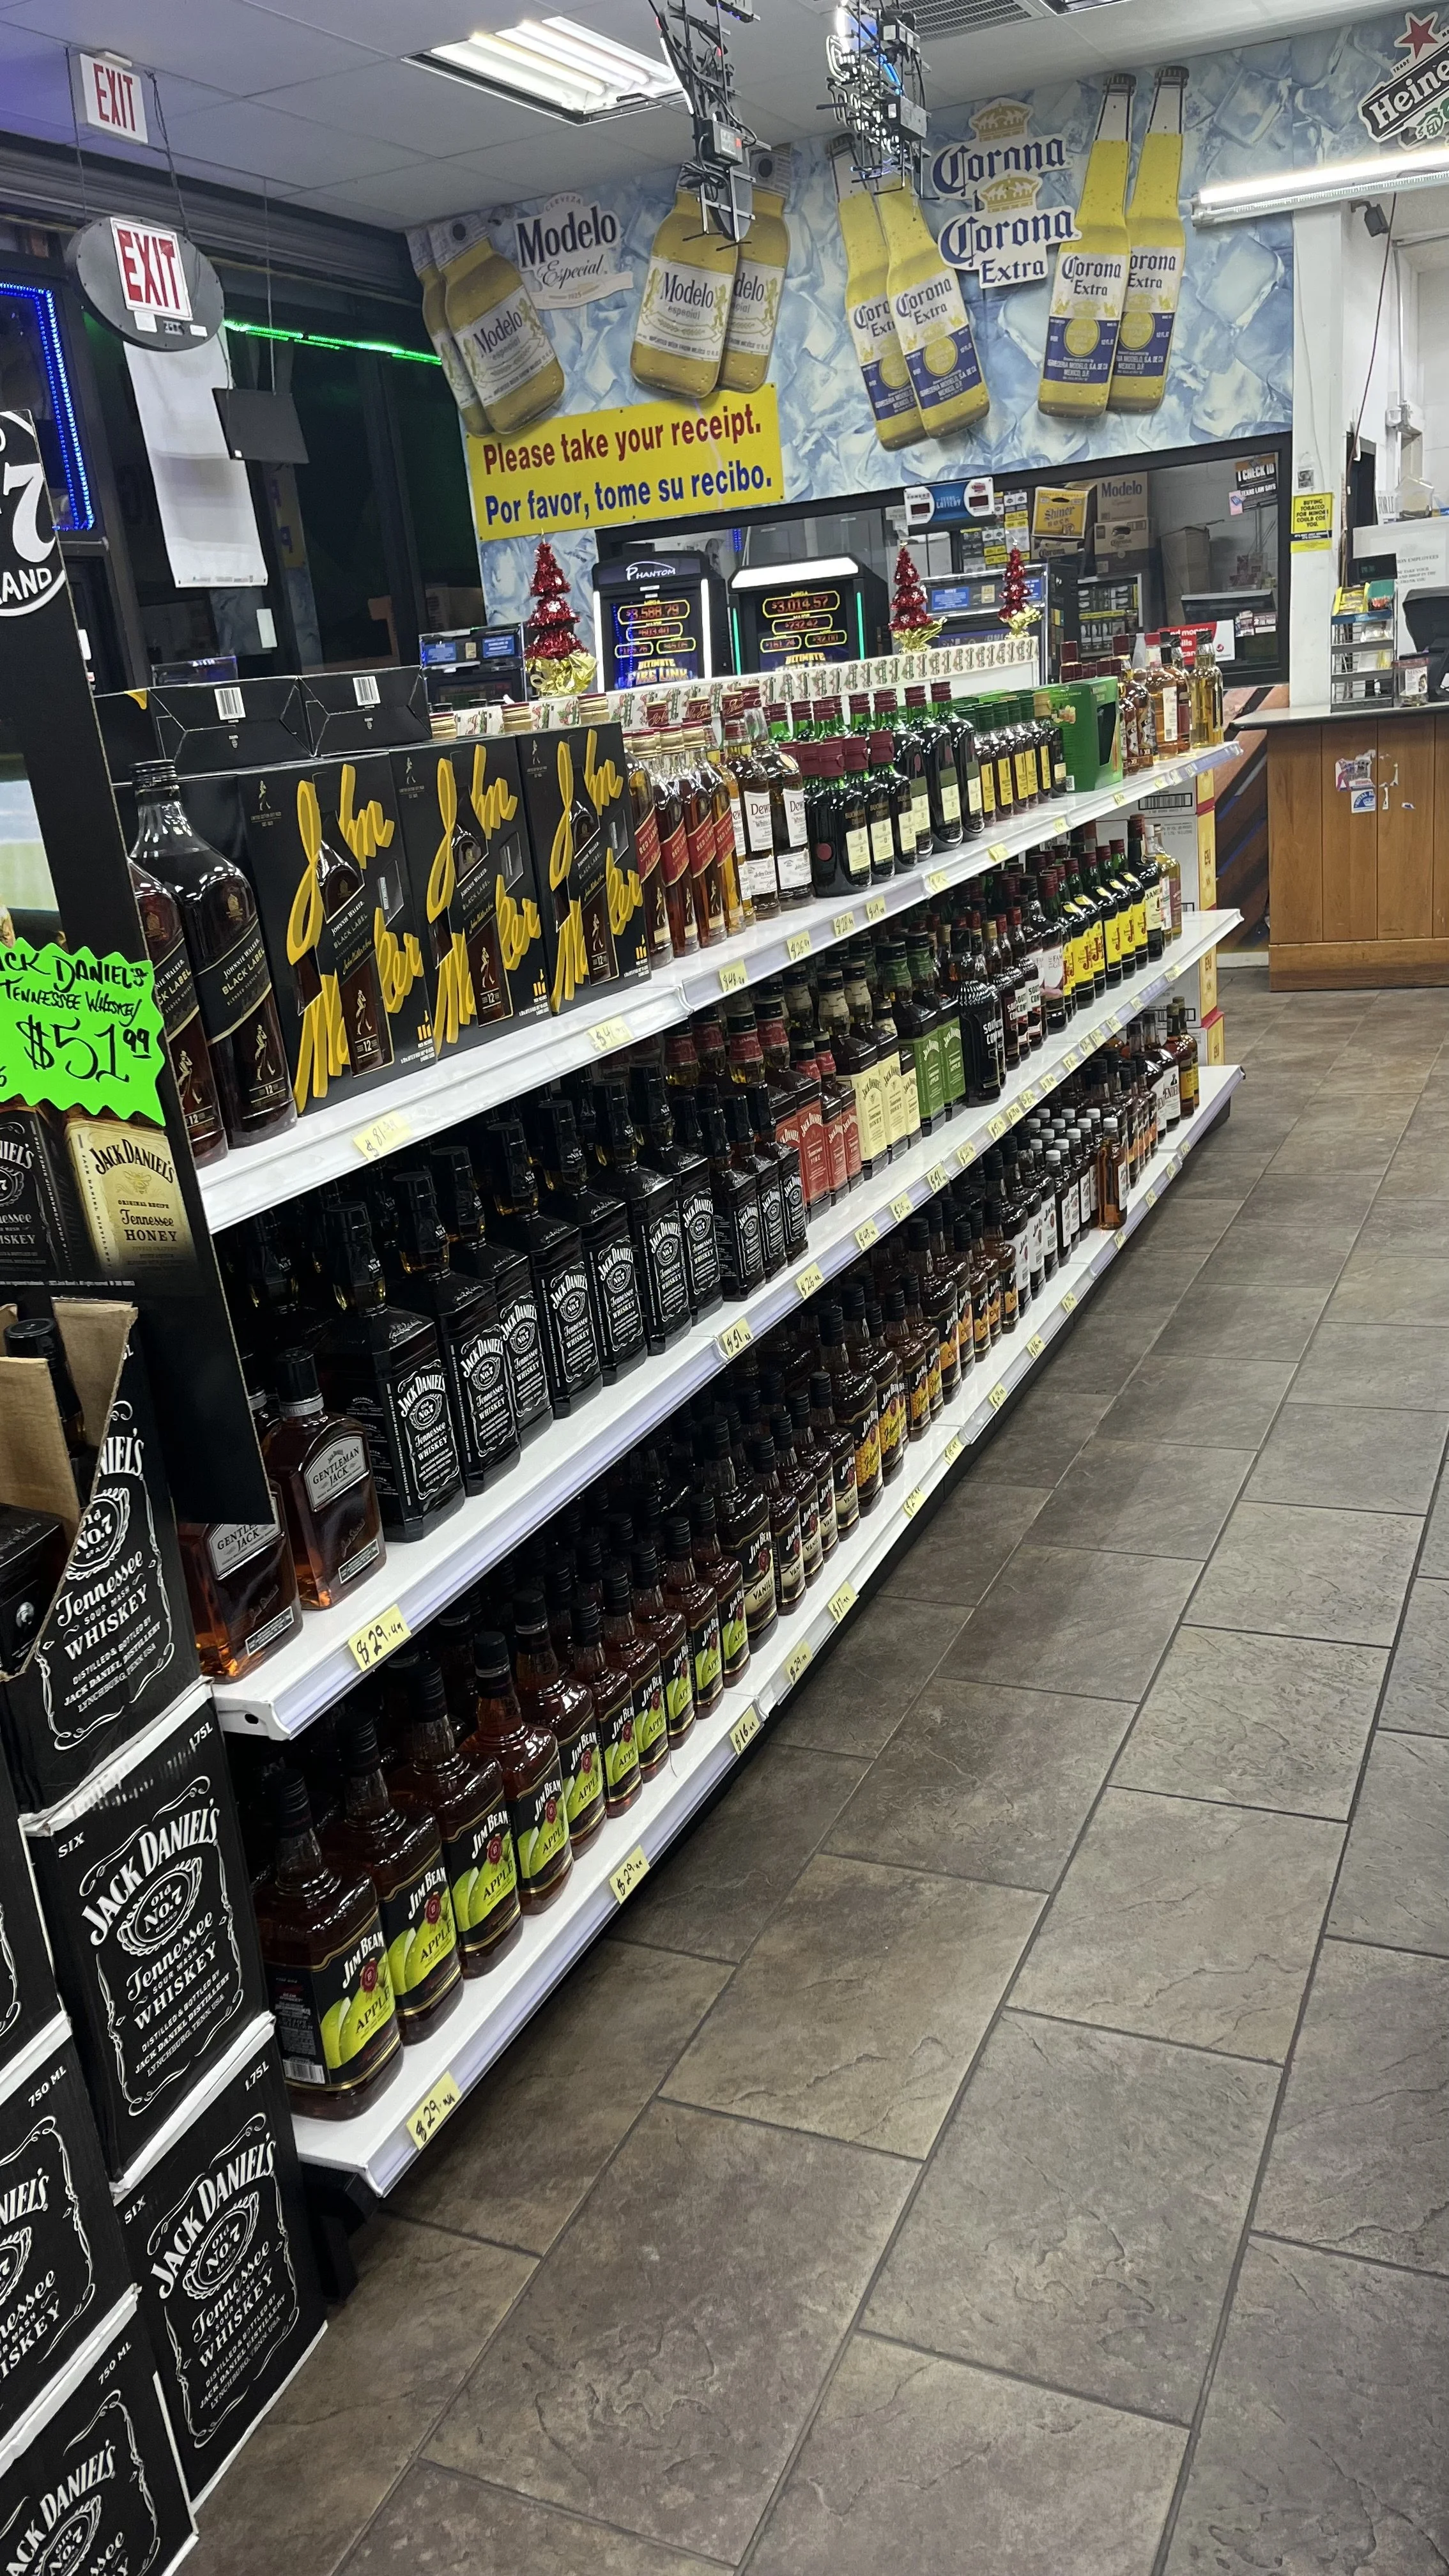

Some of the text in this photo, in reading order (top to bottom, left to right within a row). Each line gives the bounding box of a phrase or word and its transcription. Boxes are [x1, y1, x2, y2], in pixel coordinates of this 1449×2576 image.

[93, 64, 136, 132] EXIT
[933, 138, 1066, 196] Corona
[517, 206, 616, 268] Modelo
[940, 208, 1075, 268] Corona
[118, 229, 182, 310] EXIT
[537, 254, 604, 289] Especial
[981, 259, 1045, 284] Extra
[1062, 256, 1121, 282] Corona
[1128, 273, 1162, 288] Extra
[1130, 255, 1176, 271] orona
[660, 272, 714, 308] Modelo
[735, 273, 764, 302] delo
[896, 279, 952, 318] Corona
[1073, 280, 1108, 296] Extra
[473, 310, 523, 353] Modelo
[854, 300, 889, 330] Coro
[915, 303, 947, 325] Extra
[483, 404, 761, 475] Please take your receipt.
[1101, 480, 1142, 498] Modelo
[1242, 465, 1266, 481] CHECK
[1266, 463, 1275, 475] ID
[485, 460, 771, 525] Por favor, tome su recibo.
[3, 462, 56, 563] 7
[1045, 506, 1075, 521] Shiner
[626, 565, 676, 581] PHANTOM
[785, 652, 825, 664] ULTIMATE
[334, 913, 369, 949] BLACK LABEL
[52, 956, 149, 993] DANIEL'S
[169, 969, 191, 995] LABEL
[222, 947, 265, 995] BLACK LABEL
[224, 956, 245, 980] JOHNNIE
[0, 976, 142, 1027] TENNESSEE WHISKEY
[363, 1039, 372, 1052] 12
[265, 1084, 273, 1094] 12
[188, 1115, 199, 1124] 12
[89, 1138, 174, 1183] JACK DANIEL'S
[120, 1209, 174, 1227] Tennessee
[124, 1229, 177, 1242] HONEY
[550, 1282, 567, 1309] JACK
[567, 1329, 589, 1349] WHISKEY
[397, 1384, 418, 1417] JACK
[415, 1422, 446, 1448] Tennessee
[418, 1436, 447, 1460] WHISKEY
[312, 1446, 360, 1485] GENTLEMAN
[329, 1467, 349, 1487] JACK
[237, 1531, 259, 1550] JACK
[56, 1551, 143, 1627] Tennessee
[84, 1586, 130, 1625] SOUR MASH
[64, 1584, 147, 1660] WHISKEY
[571, 1744, 582, 1770] JIM
[58, 1832, 85, 1858] SIX
[471, 1810, 509, 1859] JIM BEAM
[82, 1798, 220, 1945] JACK DANIEL'S
[483, 1860, 514, 1901] APPLE
[126, 1912, 212, 2001] Tennessee
[153, 1947, 197, 1994] SOUR MASH
[343, 1930, 384, 1989] JIM BEAM
[134, 1940, 216, 2030] WHISKEY
[135, 1972, 229, 2074] JACK DANIEL DISTILLERY
[142, 2014, 177, 2053] DISTILLED
[183, 1979, 211, 2011] BOTTLED
[212, 1969, 220, 1981] BY
[356, 1985, 391, 2035] APPLE
[27, 2065, 66, 2107] 750 ML
[124, 2194, 146, 2224] SIX
[151, 2132, 276, 2299] JACK DANIEL'S
[192, 2241, 270, 2343] Tennessee
[199, 2267, 272, 2367] WHISKEY
[98, 2342, 132, 2386] 750 ML
[6, 2439, 116, 2576] ACK DANIEL'S
